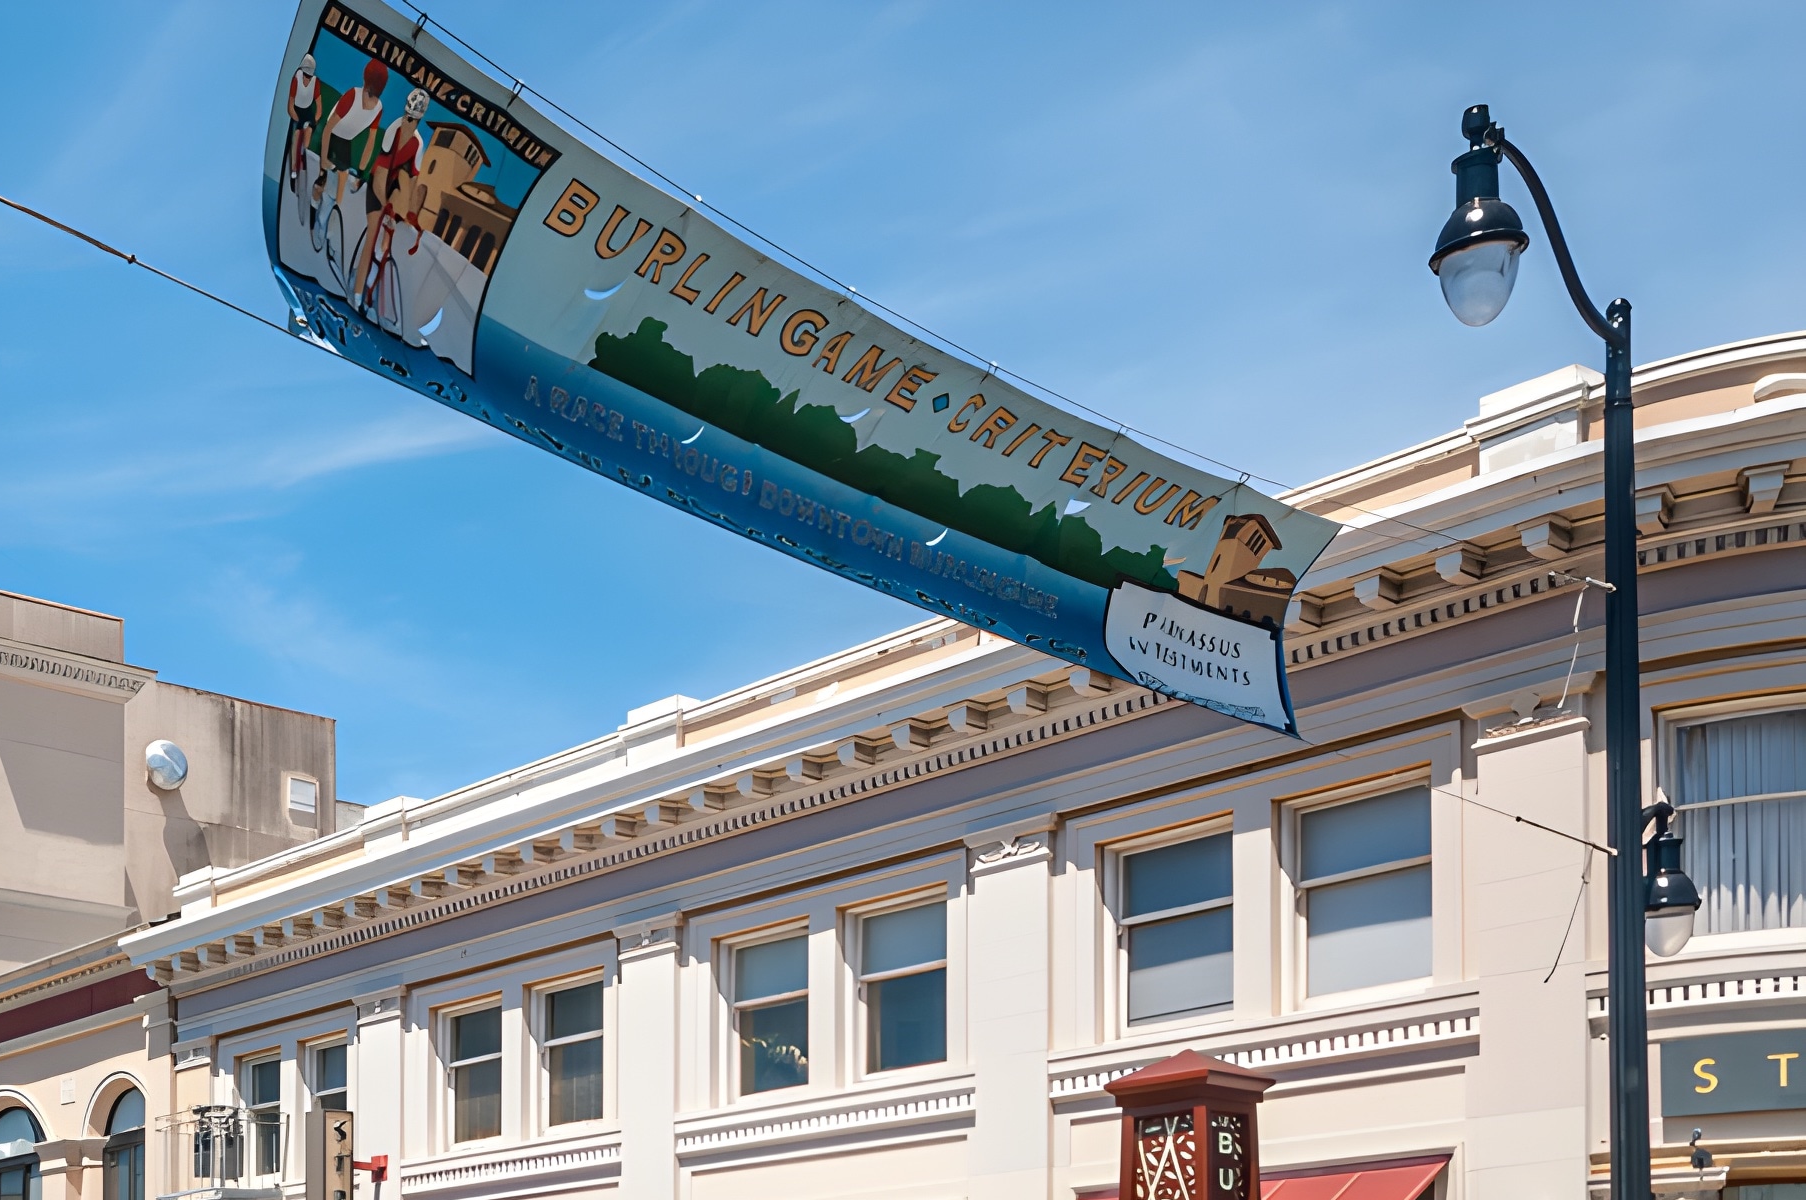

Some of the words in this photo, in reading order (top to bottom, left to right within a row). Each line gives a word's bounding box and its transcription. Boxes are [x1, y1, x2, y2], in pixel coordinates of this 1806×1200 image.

[542, 178, 937, 413] BURLINGAME
[947, 392, 1222, 532] CRITERIUM
[549, 385, 624, 442] RACE
